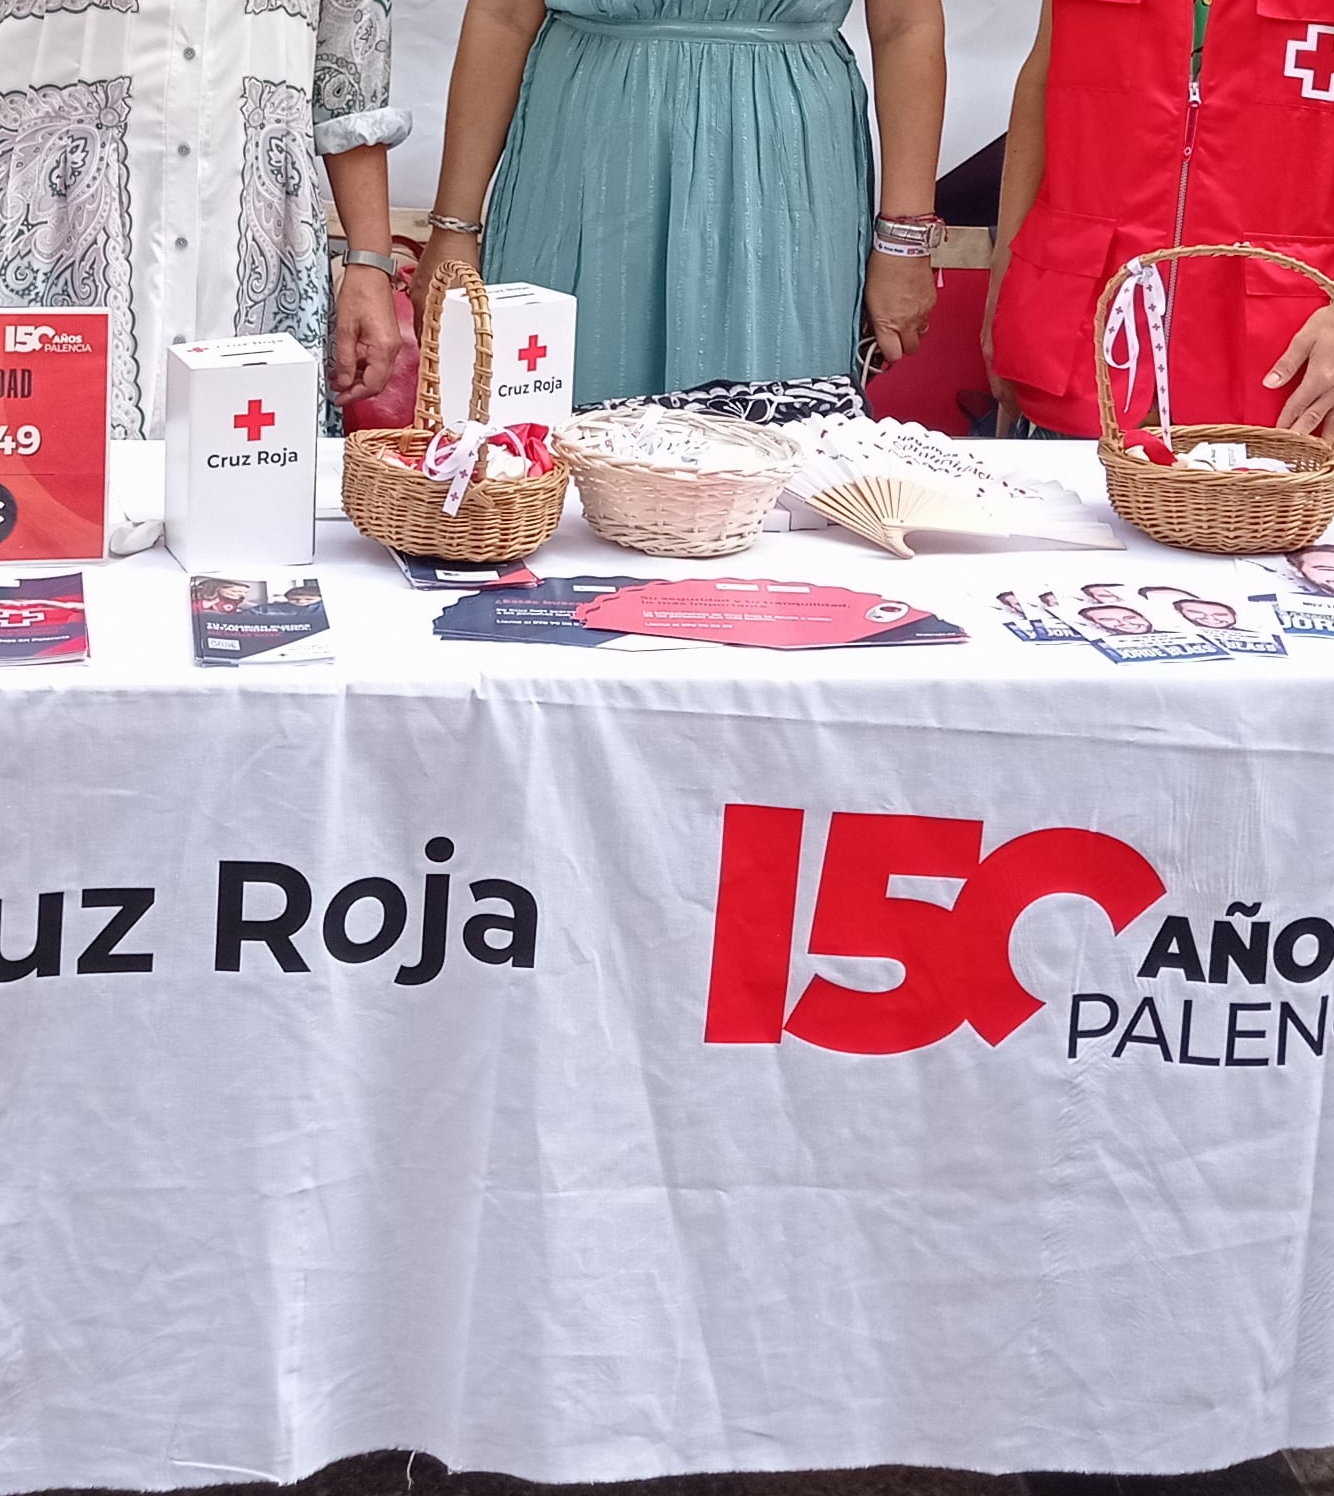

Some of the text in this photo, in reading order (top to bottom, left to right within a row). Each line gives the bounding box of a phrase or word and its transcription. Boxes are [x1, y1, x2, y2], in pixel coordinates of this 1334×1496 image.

[44, 344, 92, 353] PALENCIA
[52, 333, 83, 343] AÑOS
[498, 376, 563, 398] Cruz Roja
[207, 447, 298, 469] Cruz Roja
[214, 836, 540, 986] Roja
[704, 803, 1167, 1055] 150
